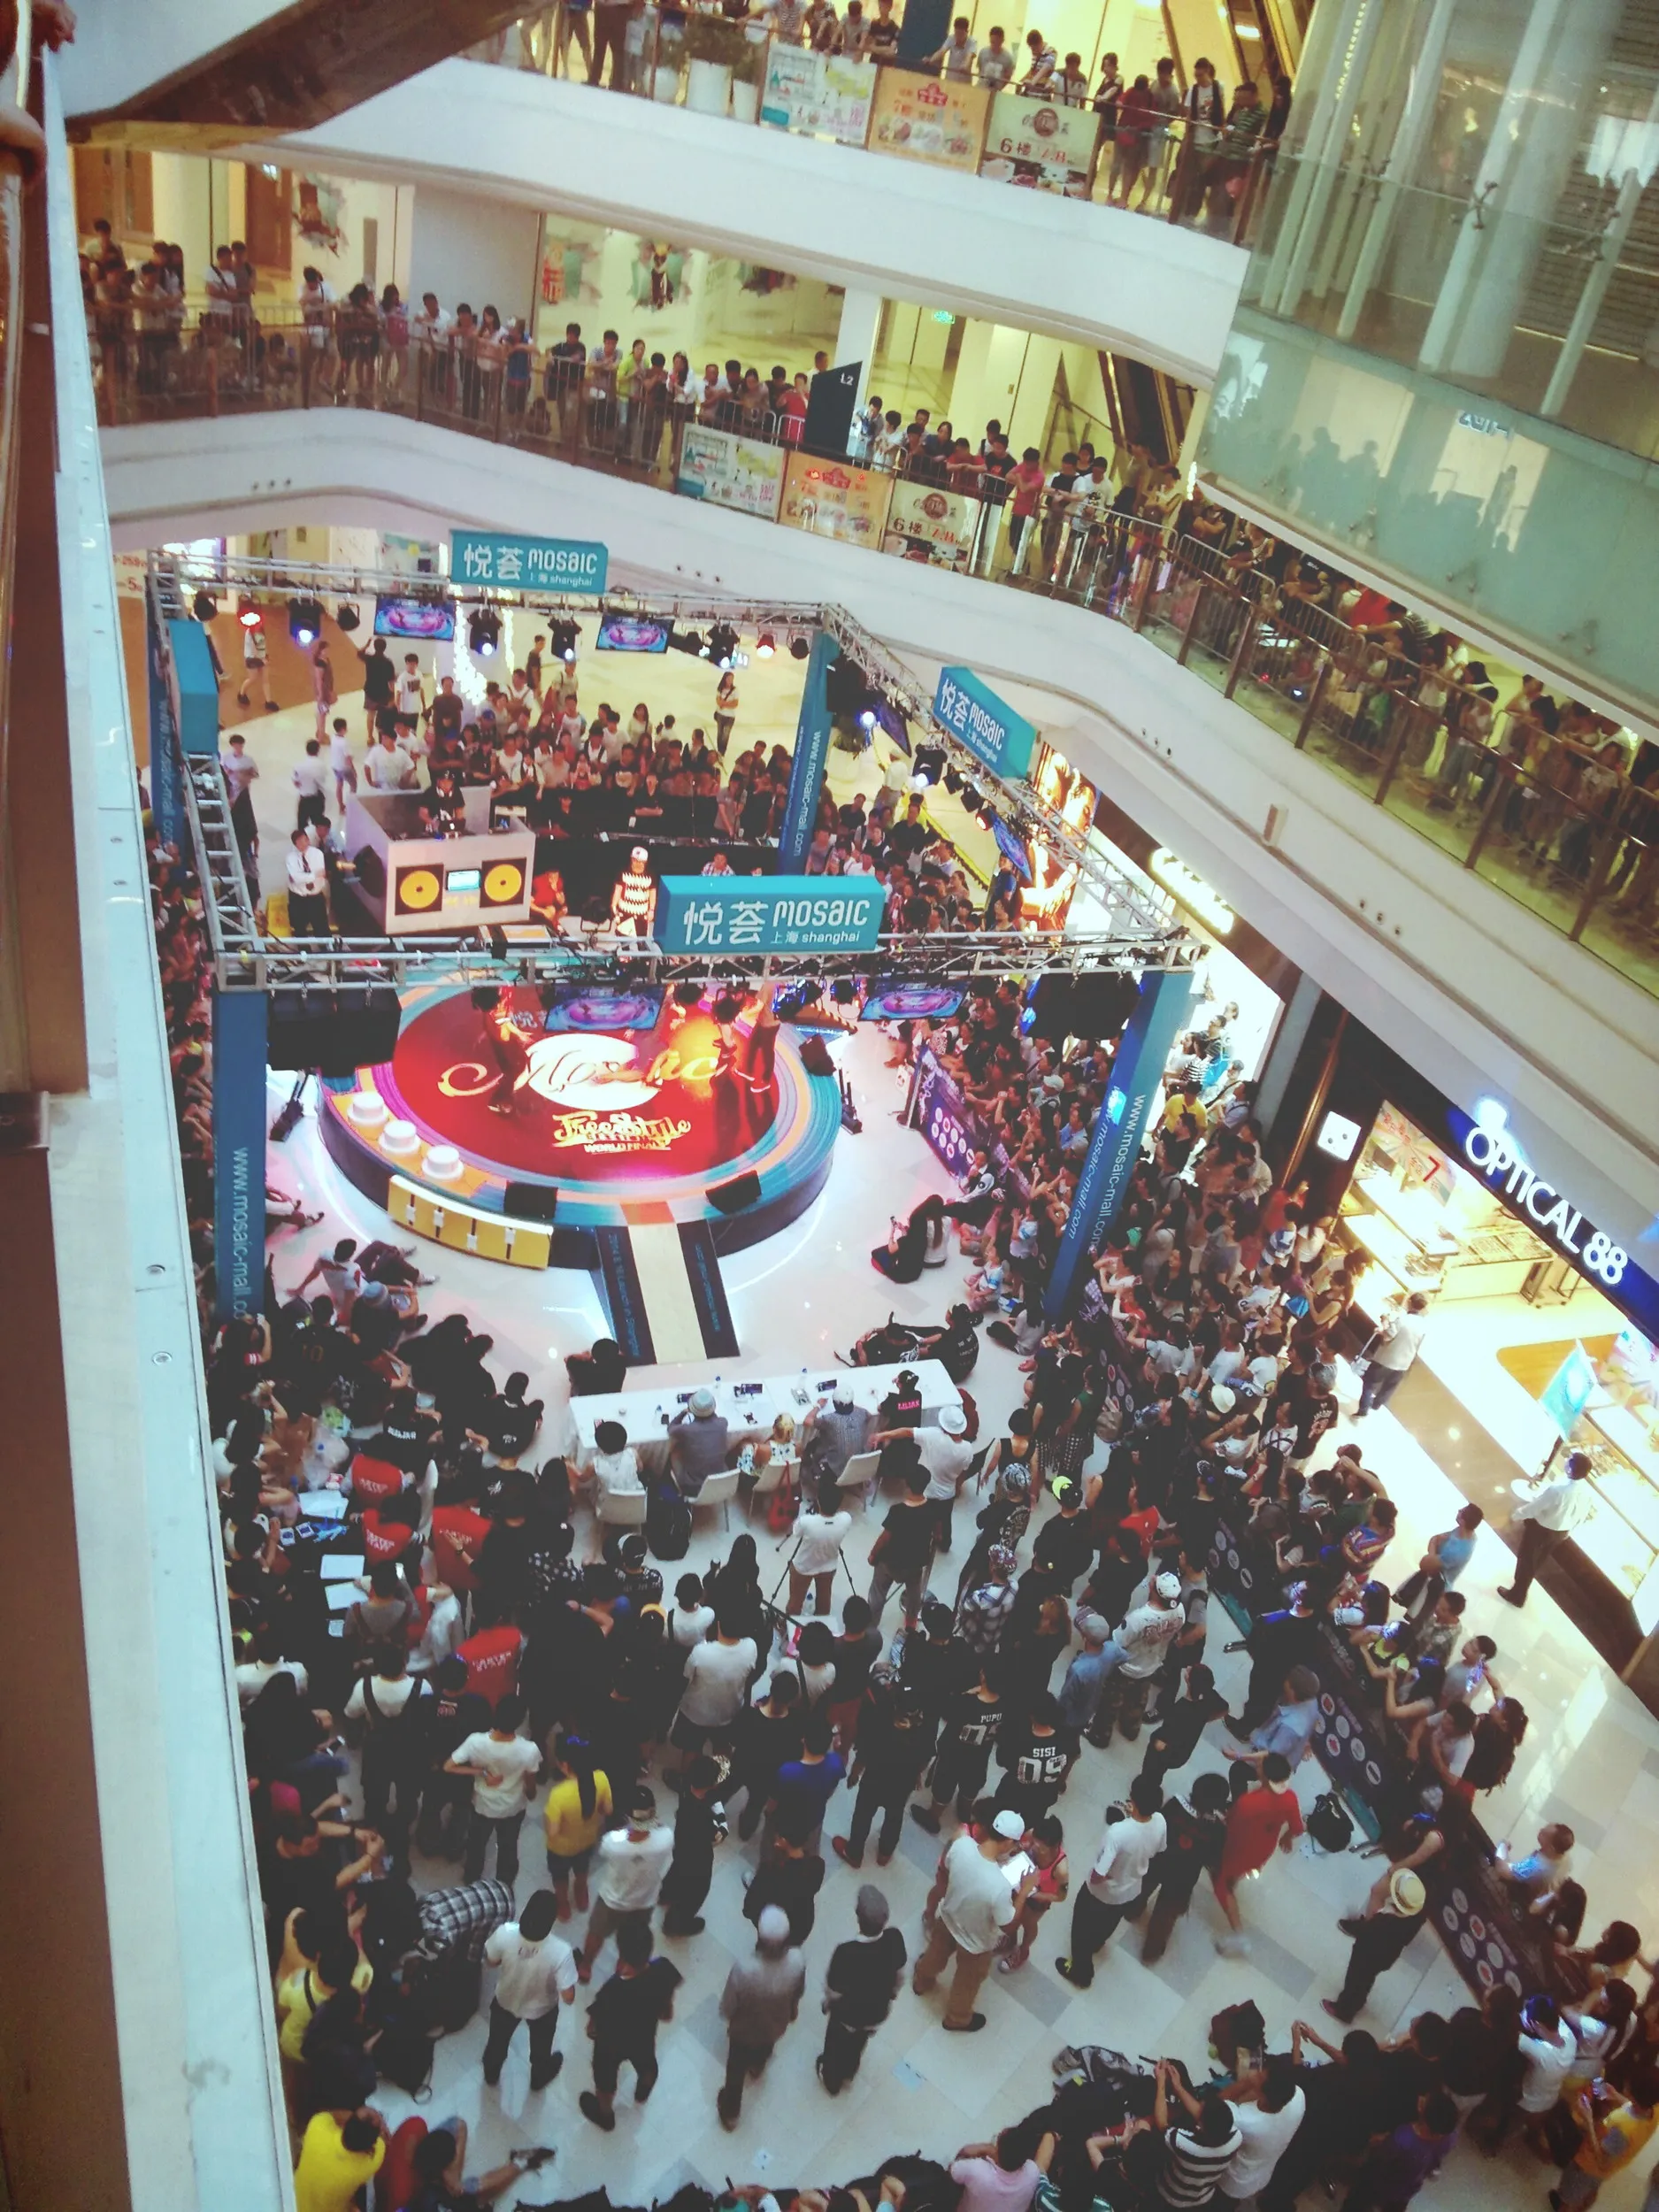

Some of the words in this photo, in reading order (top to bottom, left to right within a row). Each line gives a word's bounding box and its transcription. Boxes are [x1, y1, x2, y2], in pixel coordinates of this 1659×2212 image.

[840, 373, 854, 386] L2
[464, 542, 524, 581] 悦荟
[549, 574, 593, 588] shanghai
[940, 677, 971, 732] 悦荟
[793, 730, 821, 856] www.mosaic-mall.com
[683, 900, 769, 946] 悦荟
[770, 930, 799, 944] 上海
[802, 931, 860, 945] shanghai
[1465, 1125, 1580, 1255] OPTICAL
[1583, 1231, 1628, 1285] 88
[233, 1147, 252, 1320] www.mosaic-mall.co
[980, 1712, 1002, 1724] PUPU
[1017, 1754, 1067, 1785] 09
[1032, 1746, 1057, 1758] SISI
